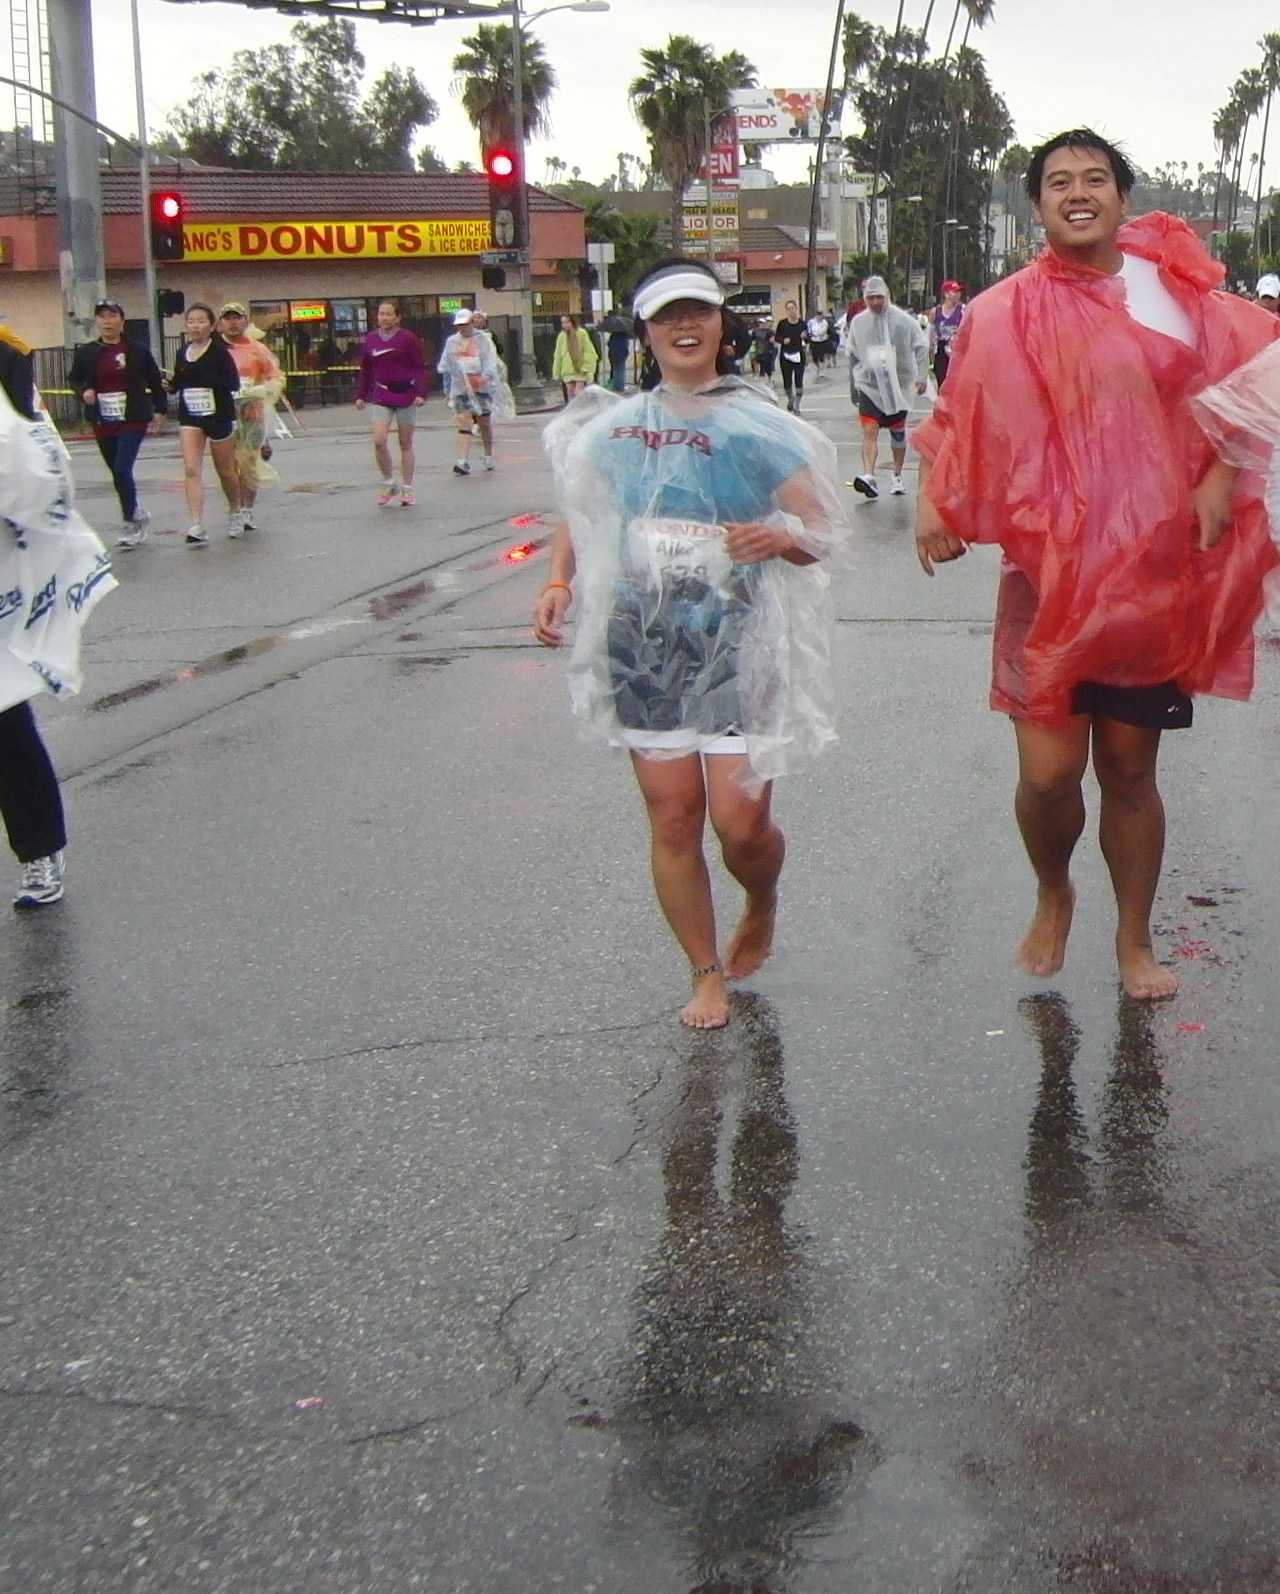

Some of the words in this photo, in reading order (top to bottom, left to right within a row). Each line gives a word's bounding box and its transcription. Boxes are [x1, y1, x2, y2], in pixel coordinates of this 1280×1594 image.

[239, 224, 422, 257] DONUTS
[429, 239, 436, 253] &
[439, 239, 456, 253] ICE
